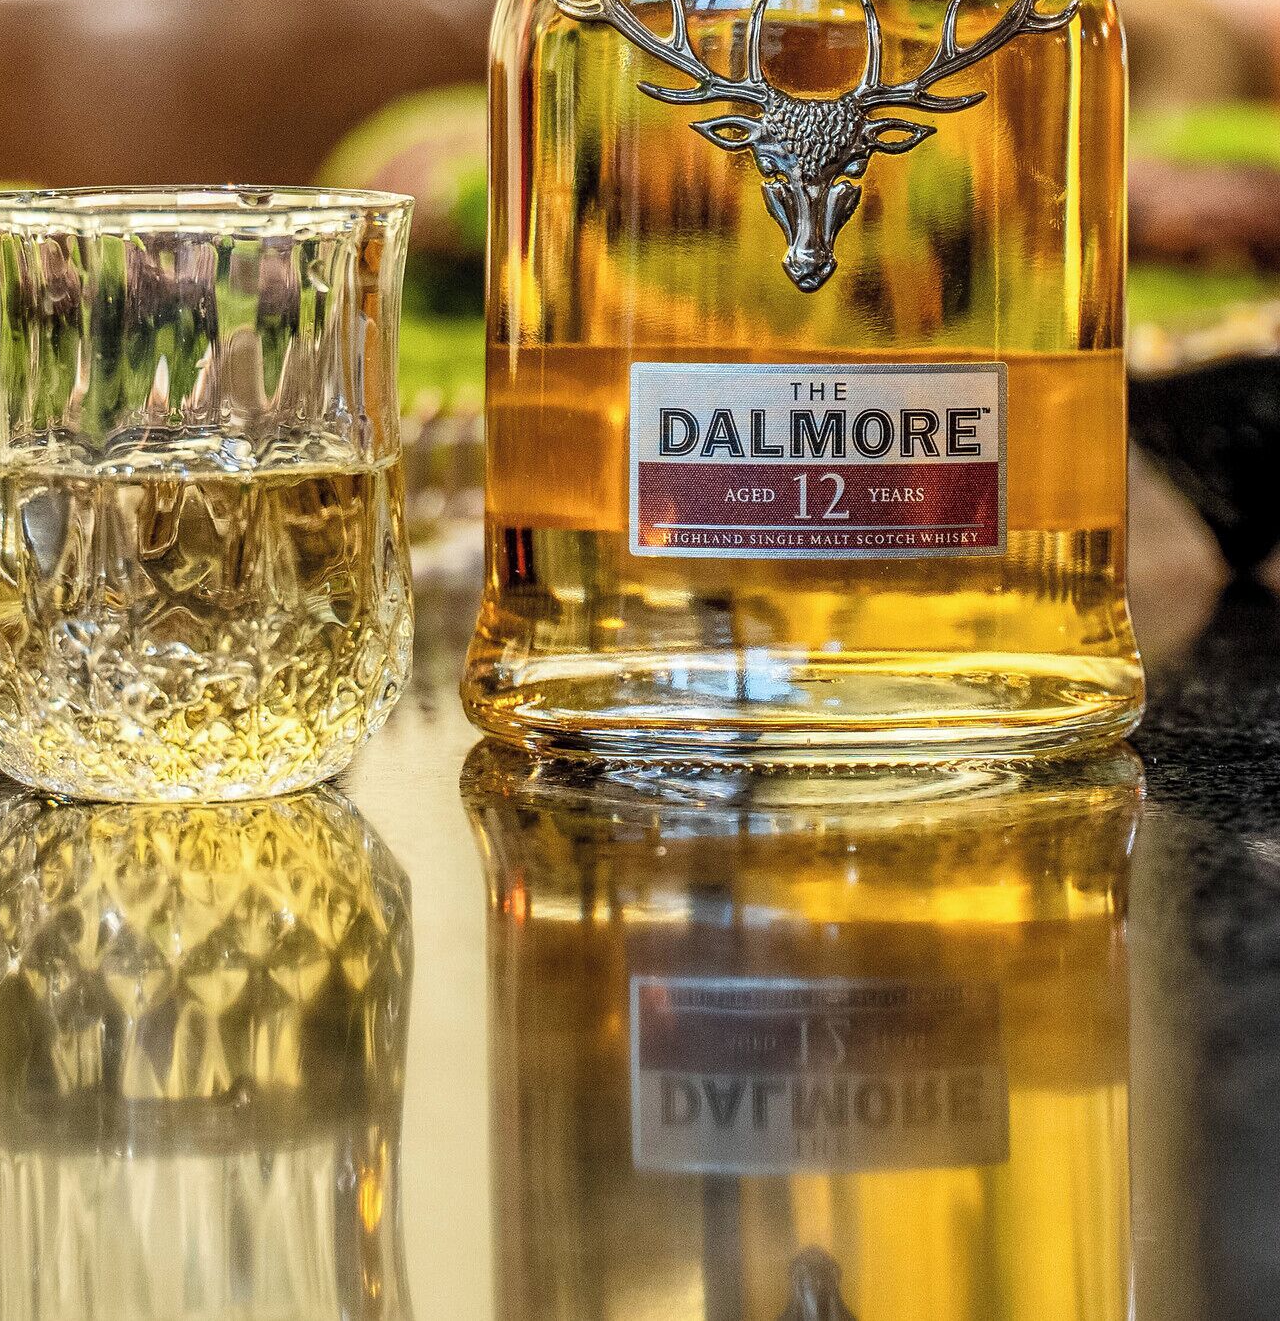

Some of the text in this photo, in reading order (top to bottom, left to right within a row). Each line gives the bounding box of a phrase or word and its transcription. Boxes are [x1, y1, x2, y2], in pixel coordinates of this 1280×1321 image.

[790, 382, 847, 401] THE
[724, 472, 924, 520] AGED 12 YEARS
[662, 532, 978, 546] HIGHLAND SINGLE MALT SCOTCH WHISKY
